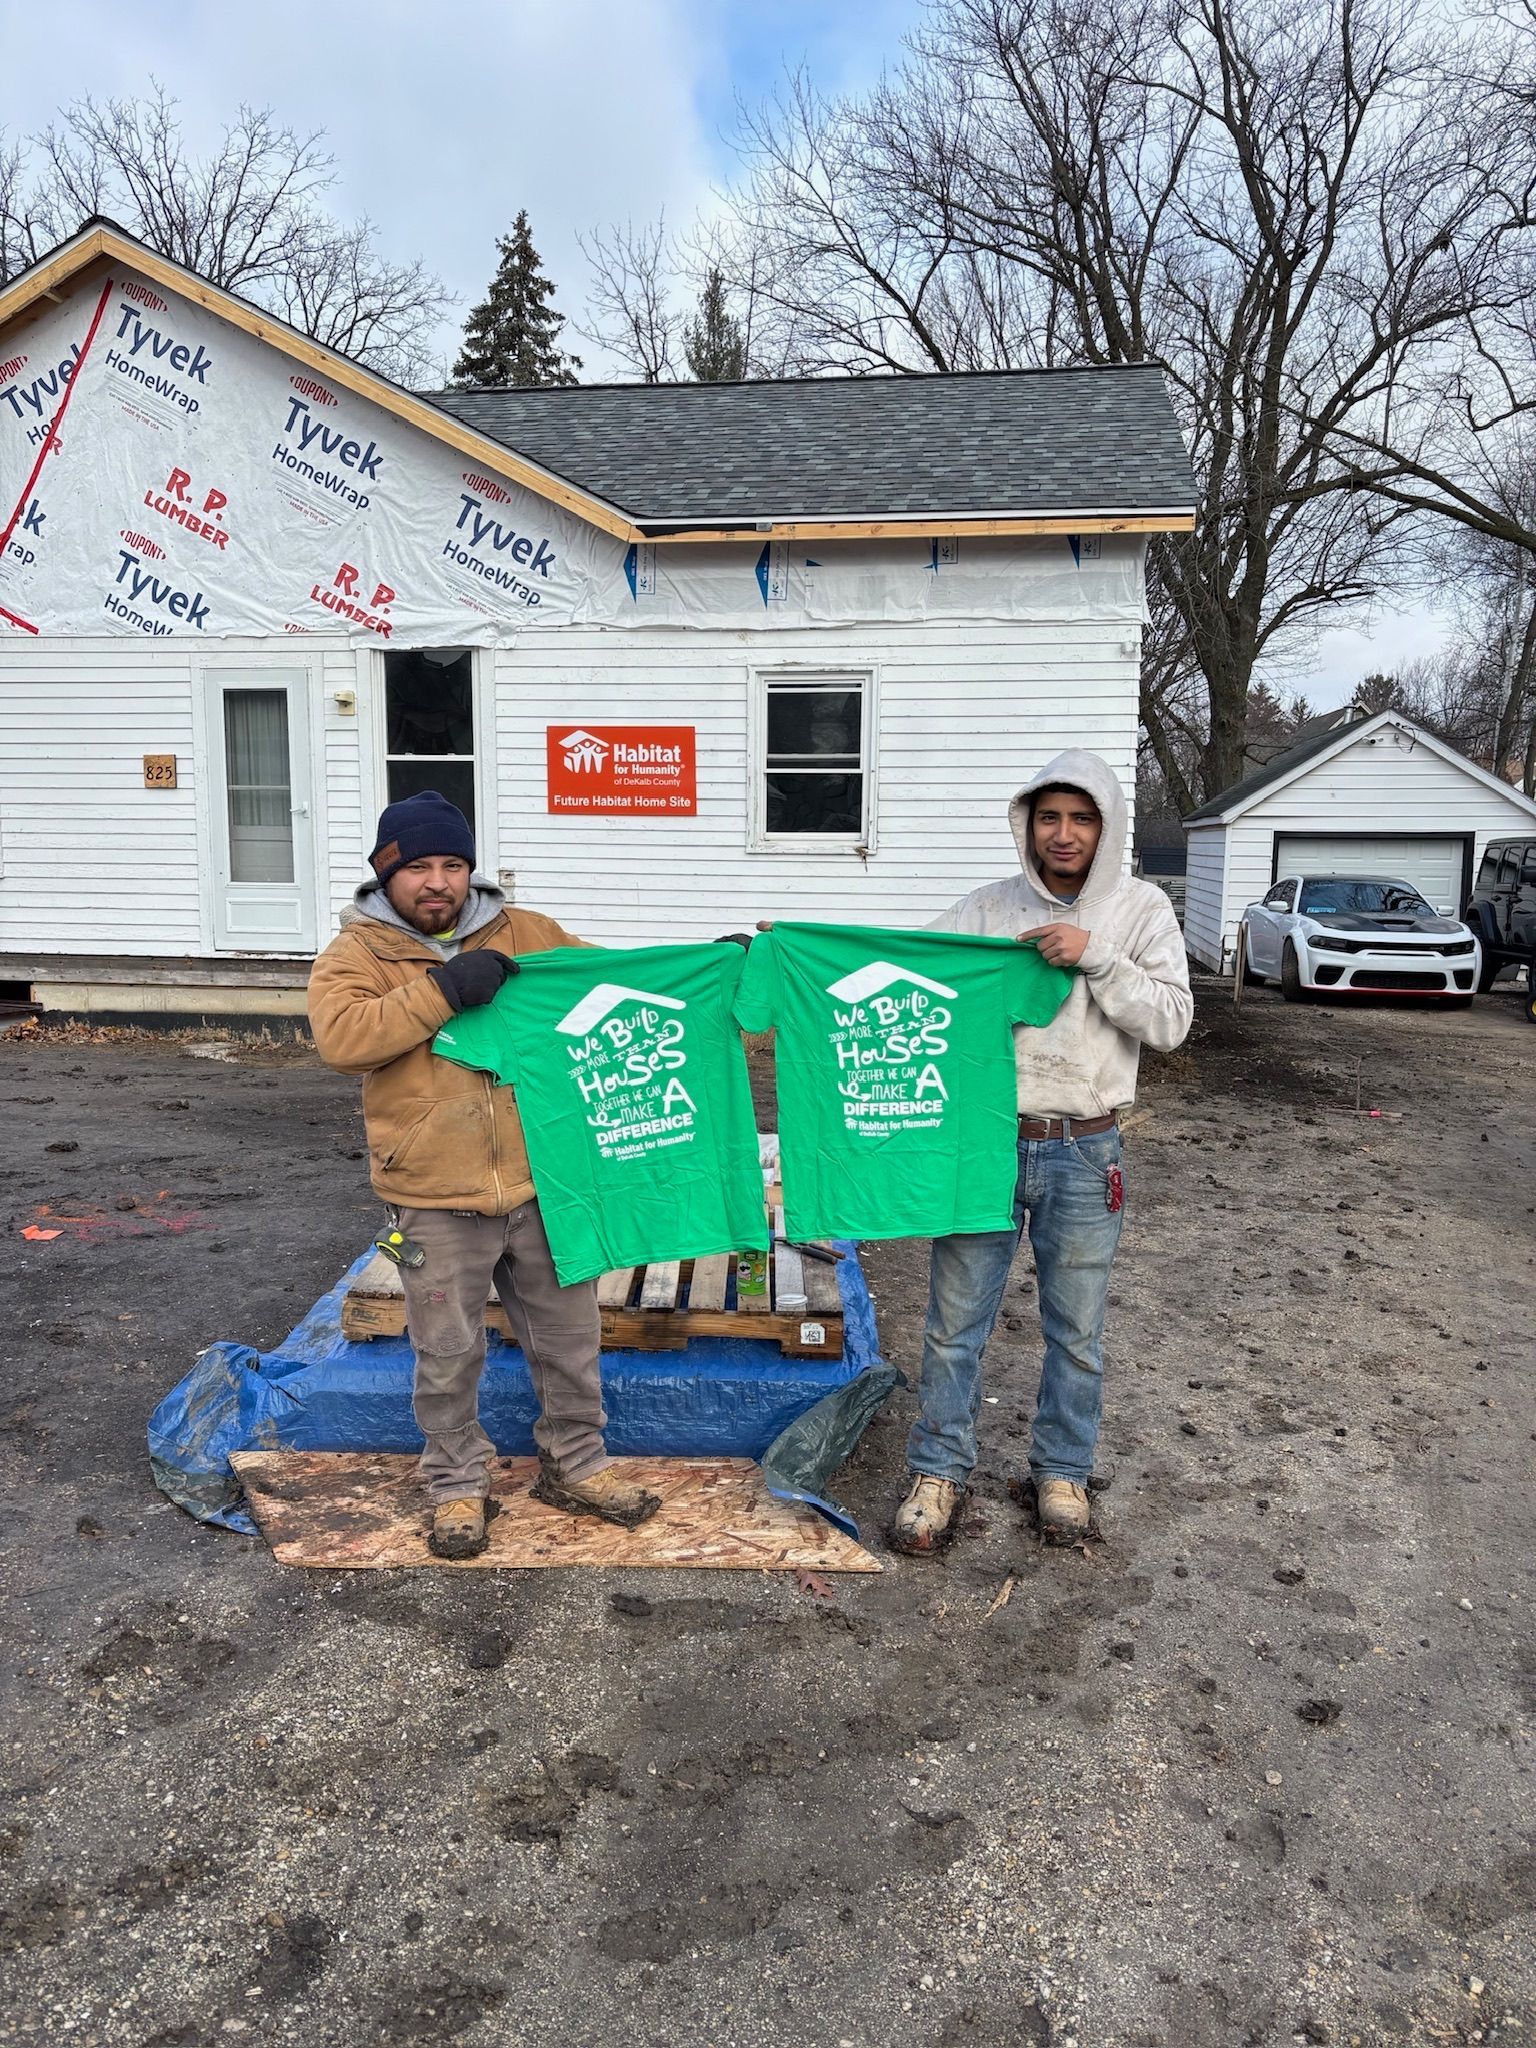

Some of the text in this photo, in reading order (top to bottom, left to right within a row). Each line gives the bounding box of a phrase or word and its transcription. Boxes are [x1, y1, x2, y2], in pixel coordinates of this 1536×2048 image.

[124, 283, 165, 312] DUPONT
[116, 303, 213, 385] Tyvek
[105, 349, 199, 414] HomeWrap
[294, 376, 334, 405] DUPONT
[280, 396, 384, 481] Tyvek
[272, 443, 371, 511] HomeWrap
[467, 473, 508, 505] DUPONT
[166, 467, 228, 522] R. P.
[144, 490, 229, 550] LUMBER
[451, 493, 557, 578] Tyvek
[124, 530, 163, 560] DUPONT
[333, 562, 396, 614] R. P.
[442, 539, 541, 607] HomeWrap
[114, 551, 211, 630] Tyvek
[310, 584, 393, 639] LUMBER
[614, 744, 681, 763] Habitat
[146, 766, 173, 780] 825
[614, 764, 681, 777] for Humanity
[614, 778, 681, 787] of DeKalb County
[554, 795, 691, 808] Future Habitat Home Site
[833, 1005, 869, 1027] We
[849, 1014, 937, 1040] MORE THAN
[566, 1036, 602, 1062] We
[586, 1028, 669, 1071] MORE THAN
[847, 1066, 917, 1082] TOGETHER WE CAN
[872, 1063, 950, 1101] MAKE A
[593, 1084, 662, 1114] TOGETHER WE CAN
[620, 1077, 697, 1124] MAKE A
[844, 1100, 943, 1116] DIFFERENCE
[596, 1112, 694, 1145] DIFFERENCE
[858, 1118, 941, 1130] Habitat for Humanity
[614, 1142, 644, 1156] Habitat
[644, 1139, 656, 1151] for
[656, 1132, 695, 1148] Humanity
